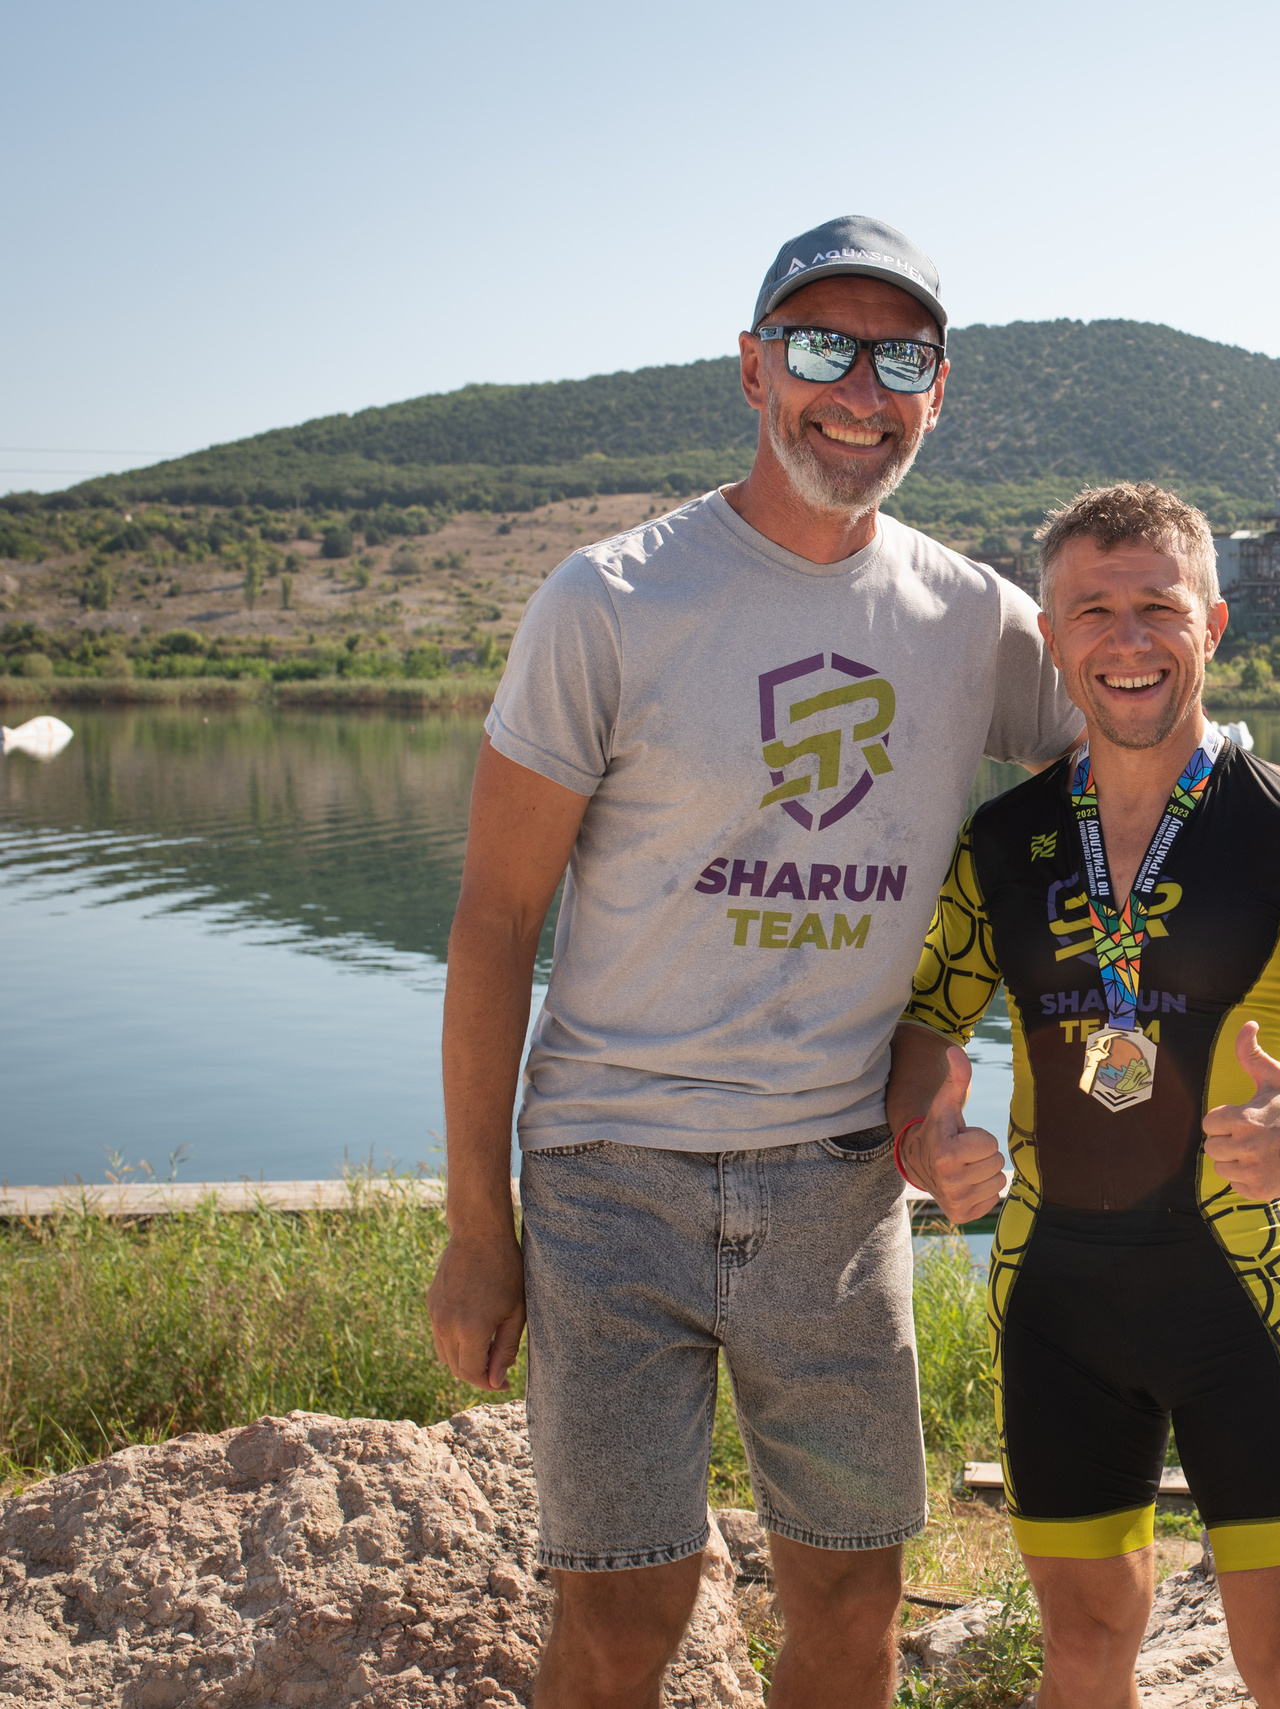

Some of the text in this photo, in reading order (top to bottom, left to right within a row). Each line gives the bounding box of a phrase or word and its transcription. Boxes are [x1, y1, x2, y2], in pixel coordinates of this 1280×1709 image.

[1076, 807, 1098, 819] 2023
[1167, 804, 1190, 818] 2023
[1078, 820, 1097, 897] ЧЕМПИОНАТ СЕВАСТОПОЛЯ
[1086, 820, 1110, 896] ПО ТРИАТЛОНУ
[1134, 814, 1172, 891] ЧЕМПИОНАТ СЕВАСТОПОЛЯ
[1141, 817, 1184, 893] ПО ТРИАТЛОНУ
[694, 857, 908, 902] SHARUN
[726, 908, 872, 950] TEAM
[1039, 988, 1187, 1015] SHAUN
[1059, 1018, 1161, 1044] TEM
